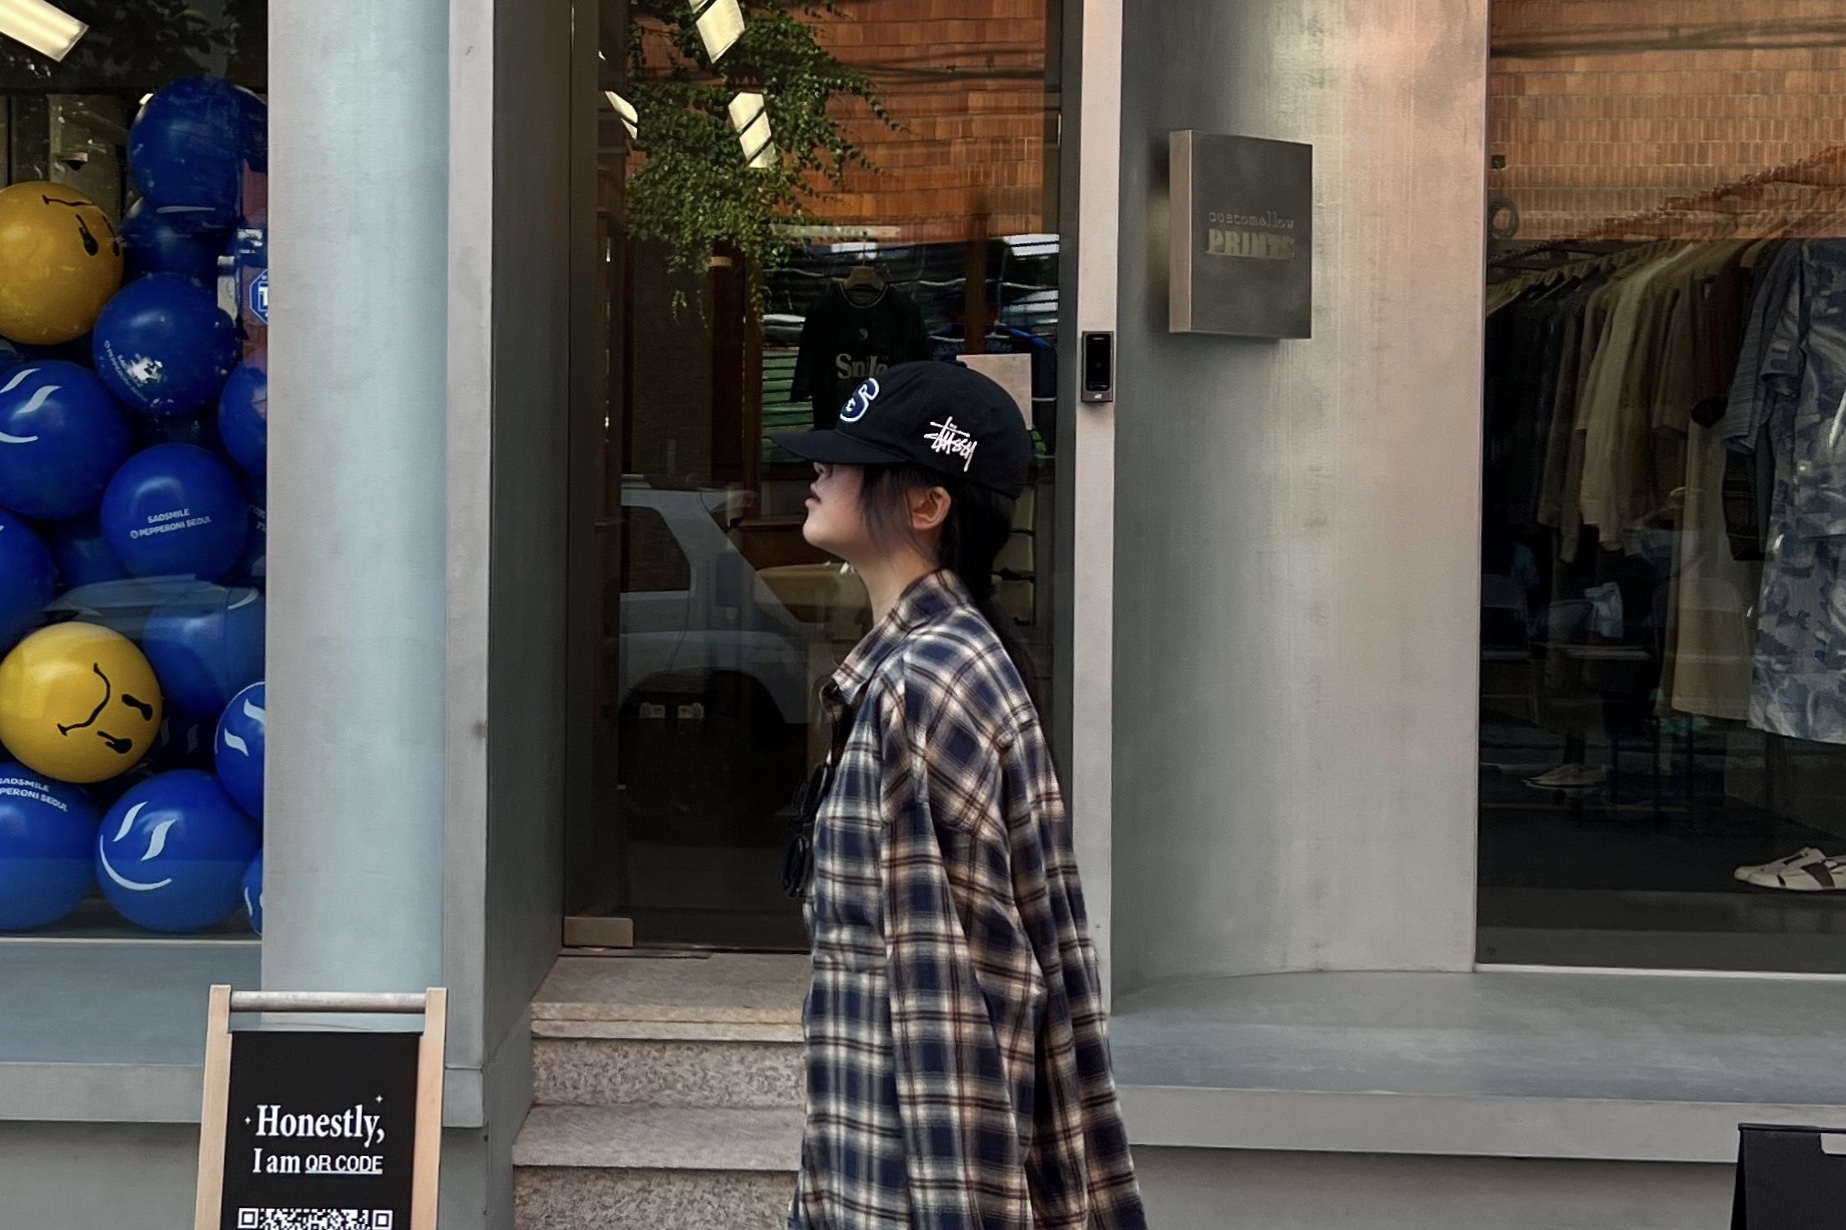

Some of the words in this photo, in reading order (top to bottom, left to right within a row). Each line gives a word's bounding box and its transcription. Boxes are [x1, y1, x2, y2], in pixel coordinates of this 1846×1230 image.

[1204, 228, 1295, 259] PRINTS
[139, 521, 185, 536] PEPPERONI
[255, 1104, 385, 1148] Honestly,
[252, 1148, 263, 1173] I
[266, 1154, 301, 1173] am
[305, 1154, 331, 1174] QR
[335, 1155, 384, 1174] CODE
